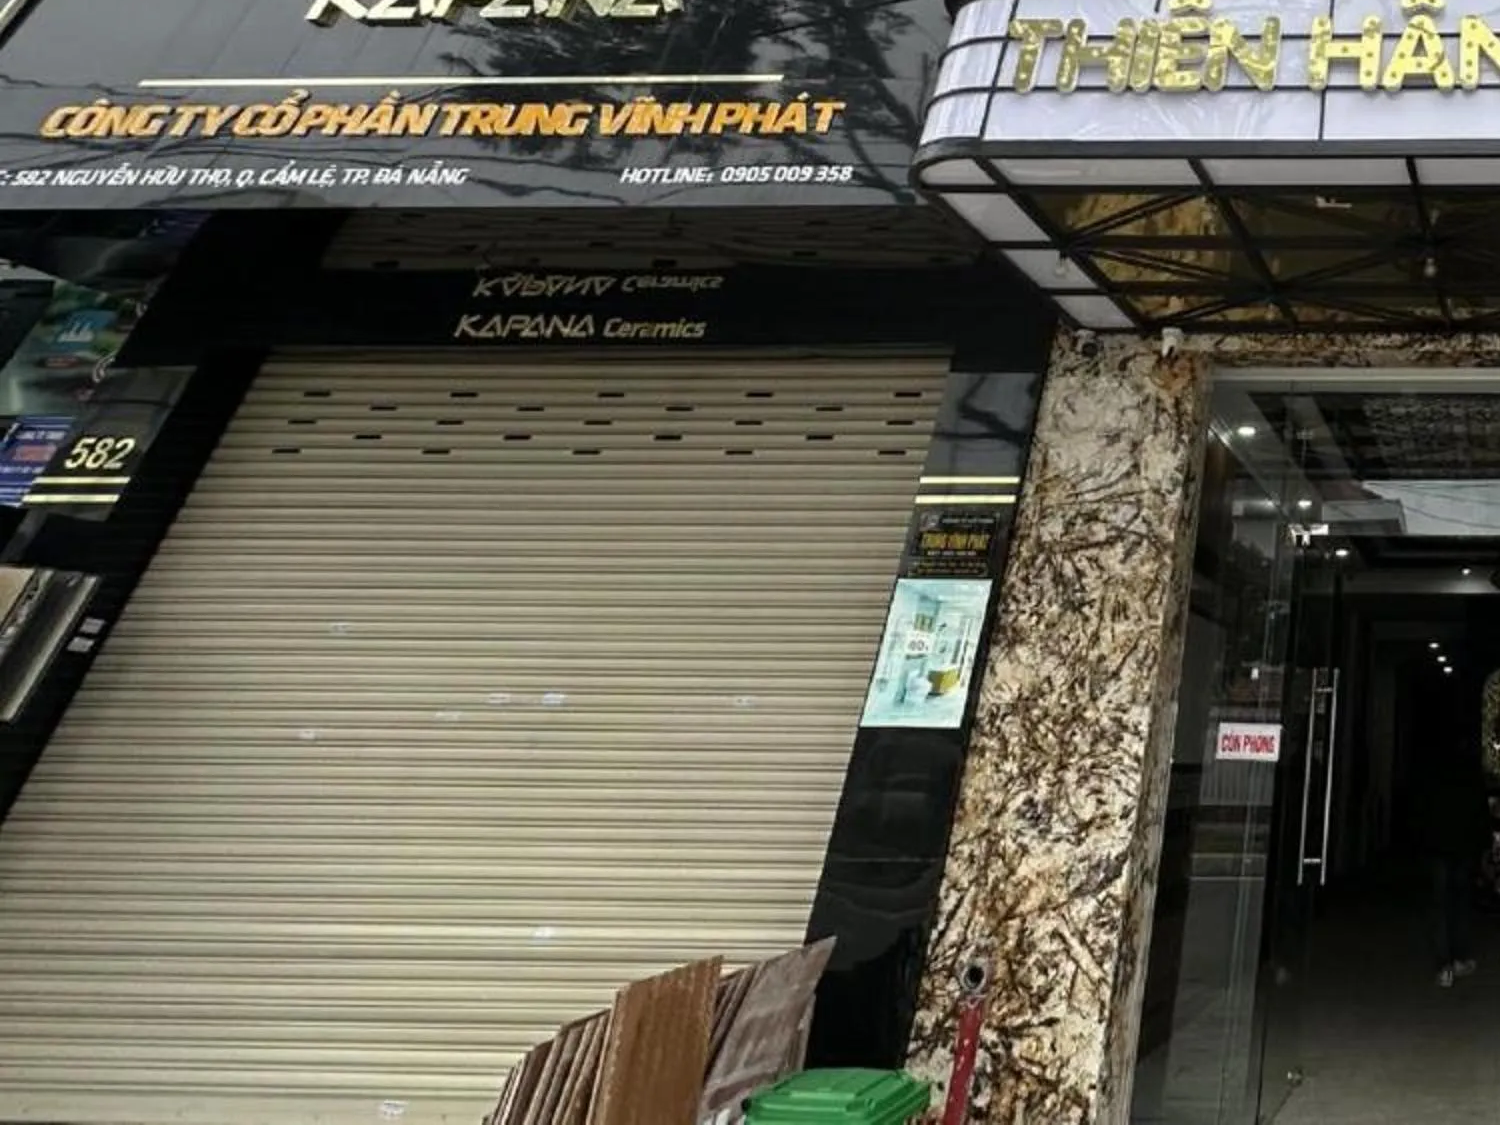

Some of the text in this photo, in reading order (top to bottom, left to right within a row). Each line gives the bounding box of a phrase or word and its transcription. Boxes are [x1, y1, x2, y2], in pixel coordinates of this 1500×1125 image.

[40, 97, 172, 138] CÔNG
[170, 103, 236, 137] TY
[231, 87, 310, 138] CỔ
[438, 102, 594, 136] TRUNG
[599, 96, 711, 135] VĨNH
[708, 92, 847, 135] PHÁT
[10, 169, 51, 186] 582
[619, 165, 854, 184] HOTLINE: 0905 009 358
[453, 313, 708, 339] KAPANA Ceramics
[63, 437, 137, 470] 582
